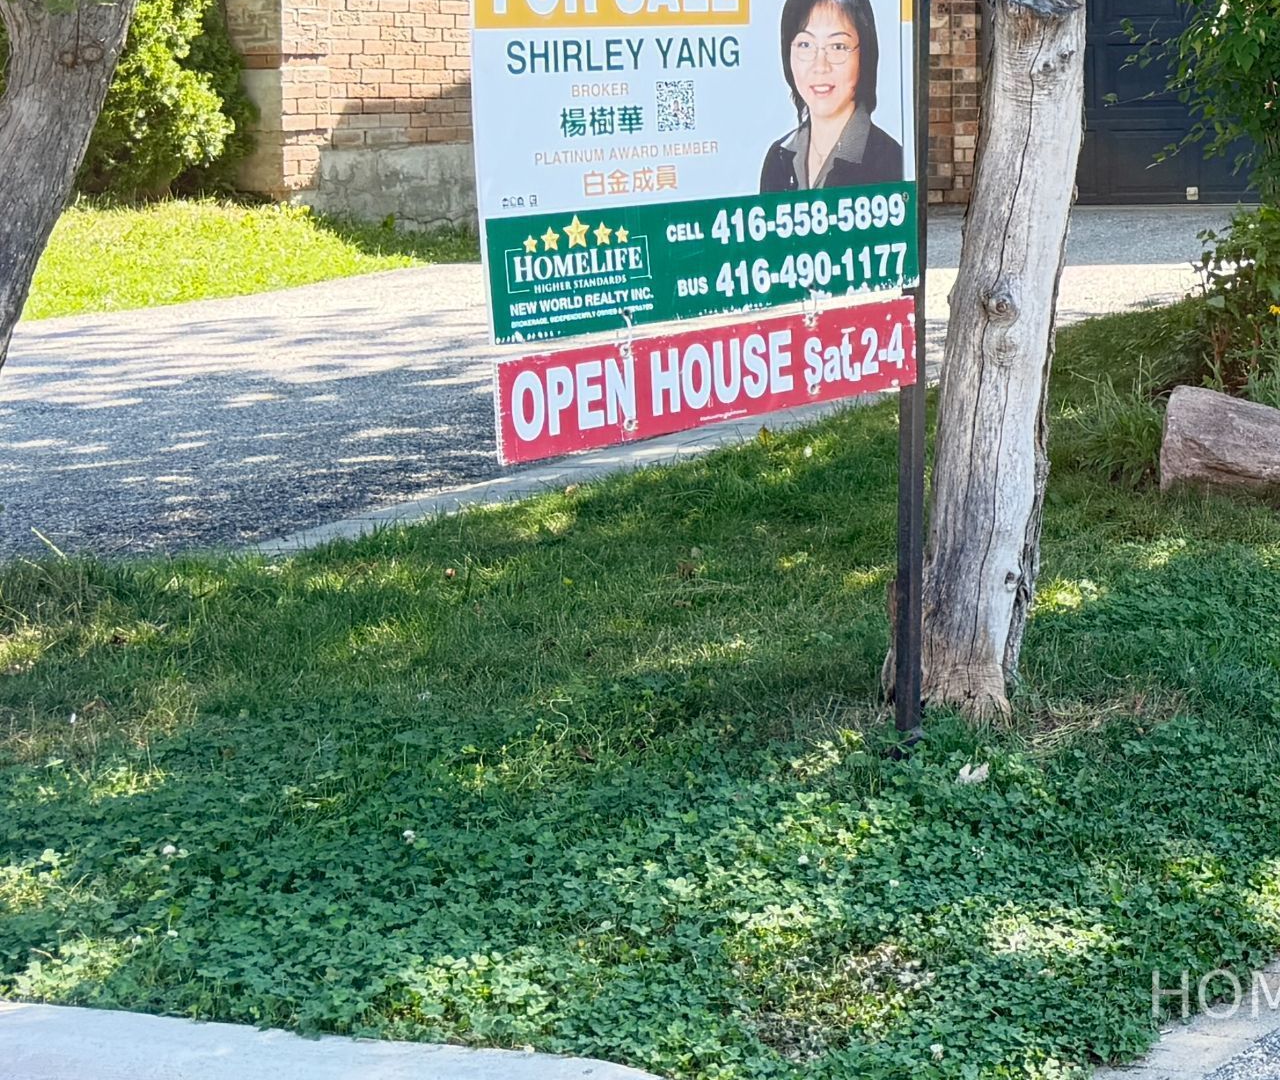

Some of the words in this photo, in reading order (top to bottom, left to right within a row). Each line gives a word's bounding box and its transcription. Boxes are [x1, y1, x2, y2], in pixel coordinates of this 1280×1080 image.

[506, 38, 644, 75] SHIRLEY
[655, 35, 740, 69] YANG
[571, 82, 629, 98] BROKER
[559, 105, 644, 138] 楊樹華
[535, 149, 605, 166] PLATINUM
[609, 145, 659, 161] AWARD
[663, 141, 719, 157] MEMBER
[583, 164, 678, 197] 白金成員
[666, 222, 705, 243] CELL
[711, 192, 906, 245] 416-558-5899
[534, 281, 572, 294] HIGHER
[573, 275, 627, 289] STANDARDS
[677, 276, 709, 297] BUS
[715, 242, 907, 297] 416-490-1177
[509, 301, 538, 317] NEW
[539, 295, 583, 313] WORLD
[585, 289, 629, 307] REALTY
[631, 286, 654, 301] INC.
[511, 356, 637, 442] OPEN
[650, 329, 794, 417] HOUSE
